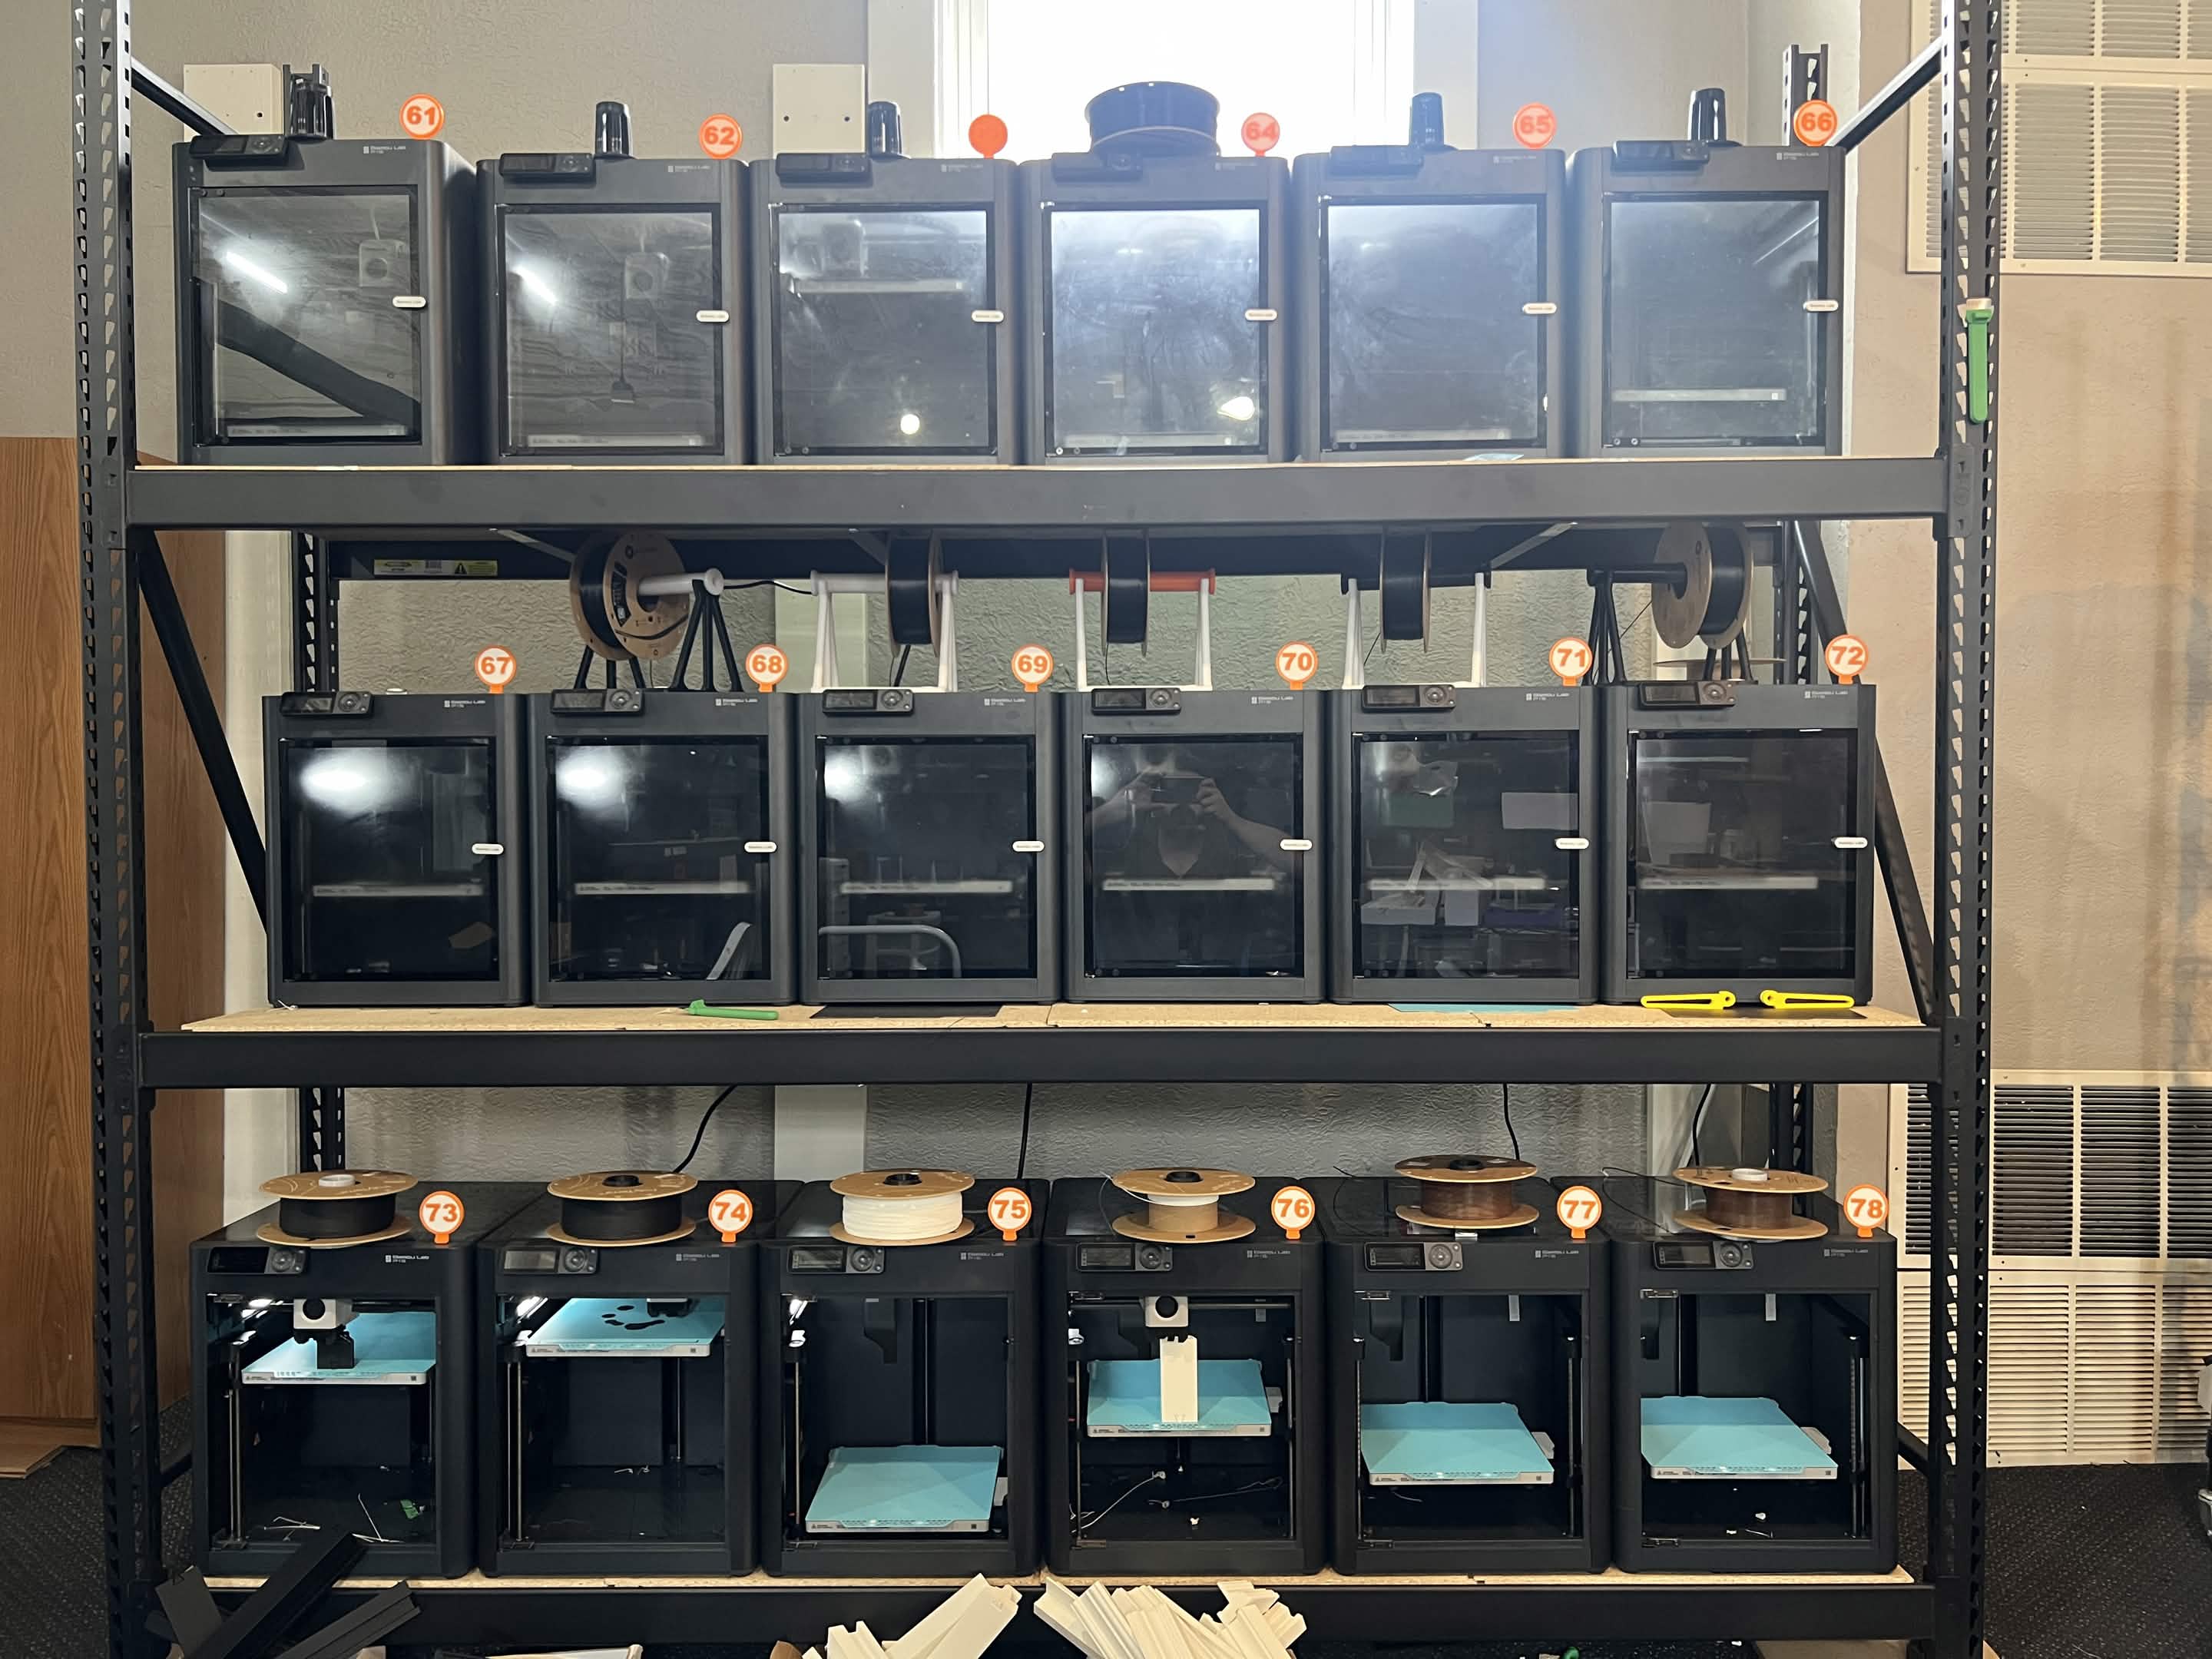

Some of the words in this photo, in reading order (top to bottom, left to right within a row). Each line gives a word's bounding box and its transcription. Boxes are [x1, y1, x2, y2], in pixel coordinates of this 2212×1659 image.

[406, 106, 435, 125] 61
[1519, 115, 1551, 134] 65
[1801, 112, 1832, 131] 66
[704, 125, 735, 145] 62
[1246, 122, 1277, 141] 64
[752, 654, 783, 674] 68
[1018, 654, 1048, 674] 69
[1282, 653, 1313, 671] 70
[1557, 649, 1586, 667] 71
[1831, 646, 1863, 665] 72
[481, 656, 511, 675] 67
[426, 1203, 458, 1223] 73
[715, 1201, 747, 1222] 74
[995, 1200, 1027, 1219] 75
[1277, 1198, 1310, 1218] 76
[1564, 1200, 1596, 1220] 77
[1851, 1198, 1883, 1219] 78
